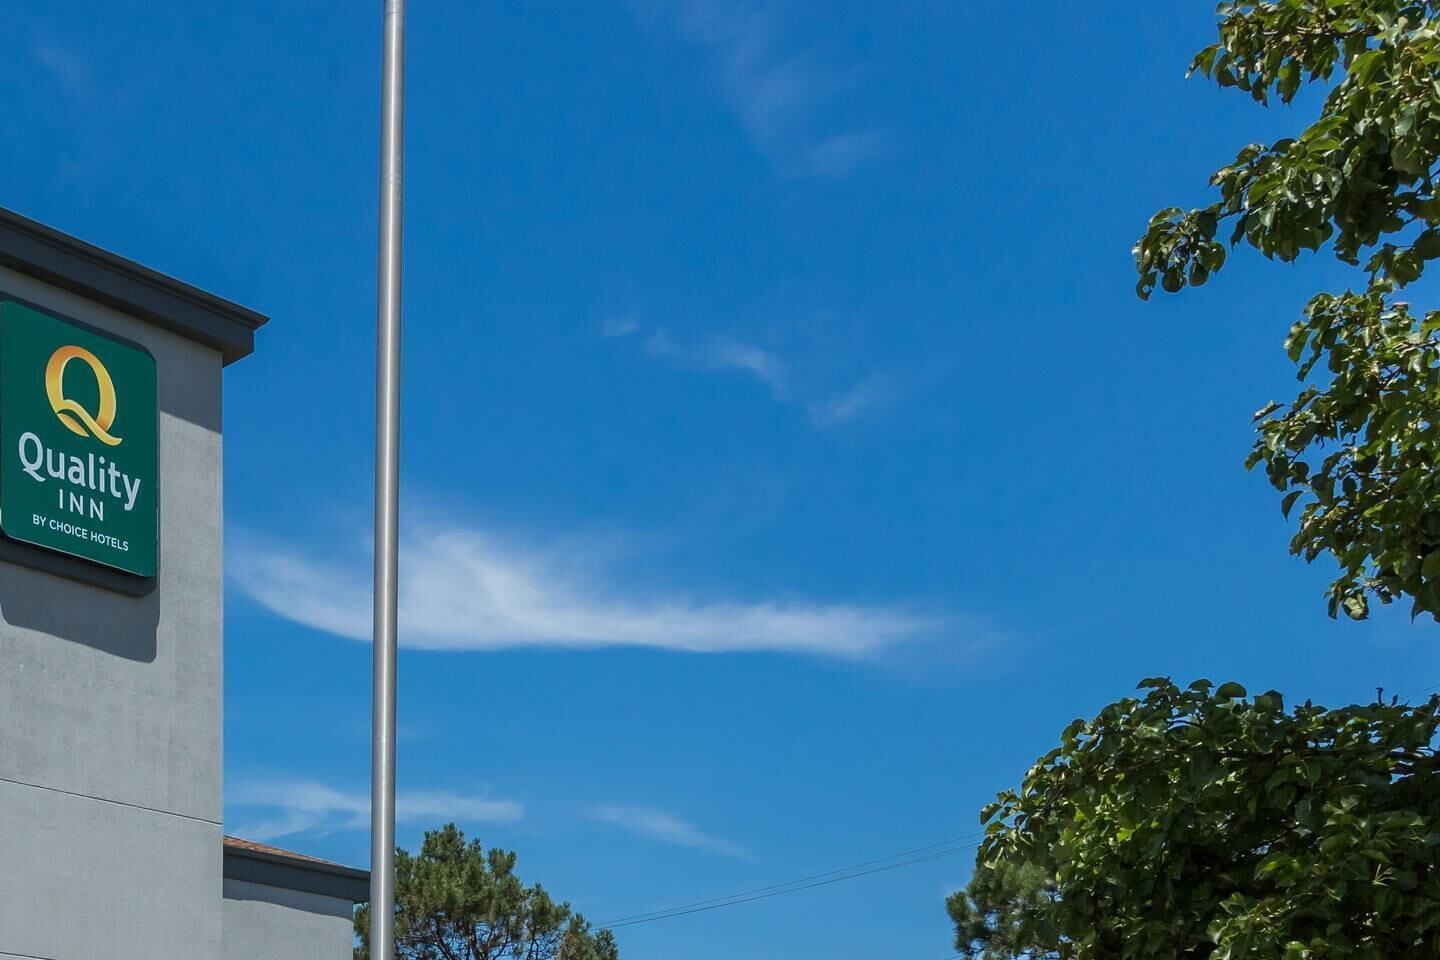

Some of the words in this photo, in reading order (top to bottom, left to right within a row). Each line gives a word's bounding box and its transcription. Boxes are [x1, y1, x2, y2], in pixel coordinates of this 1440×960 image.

[46, 346, 123, 446] Q
[18, 431, 141, 511] Quality
[33, 513, 47, 527] BY
[49, 519, 88, 540] CHOICE
[90, 531, 129, 552] HOTELS
[59, 488, 104, 522] INN
